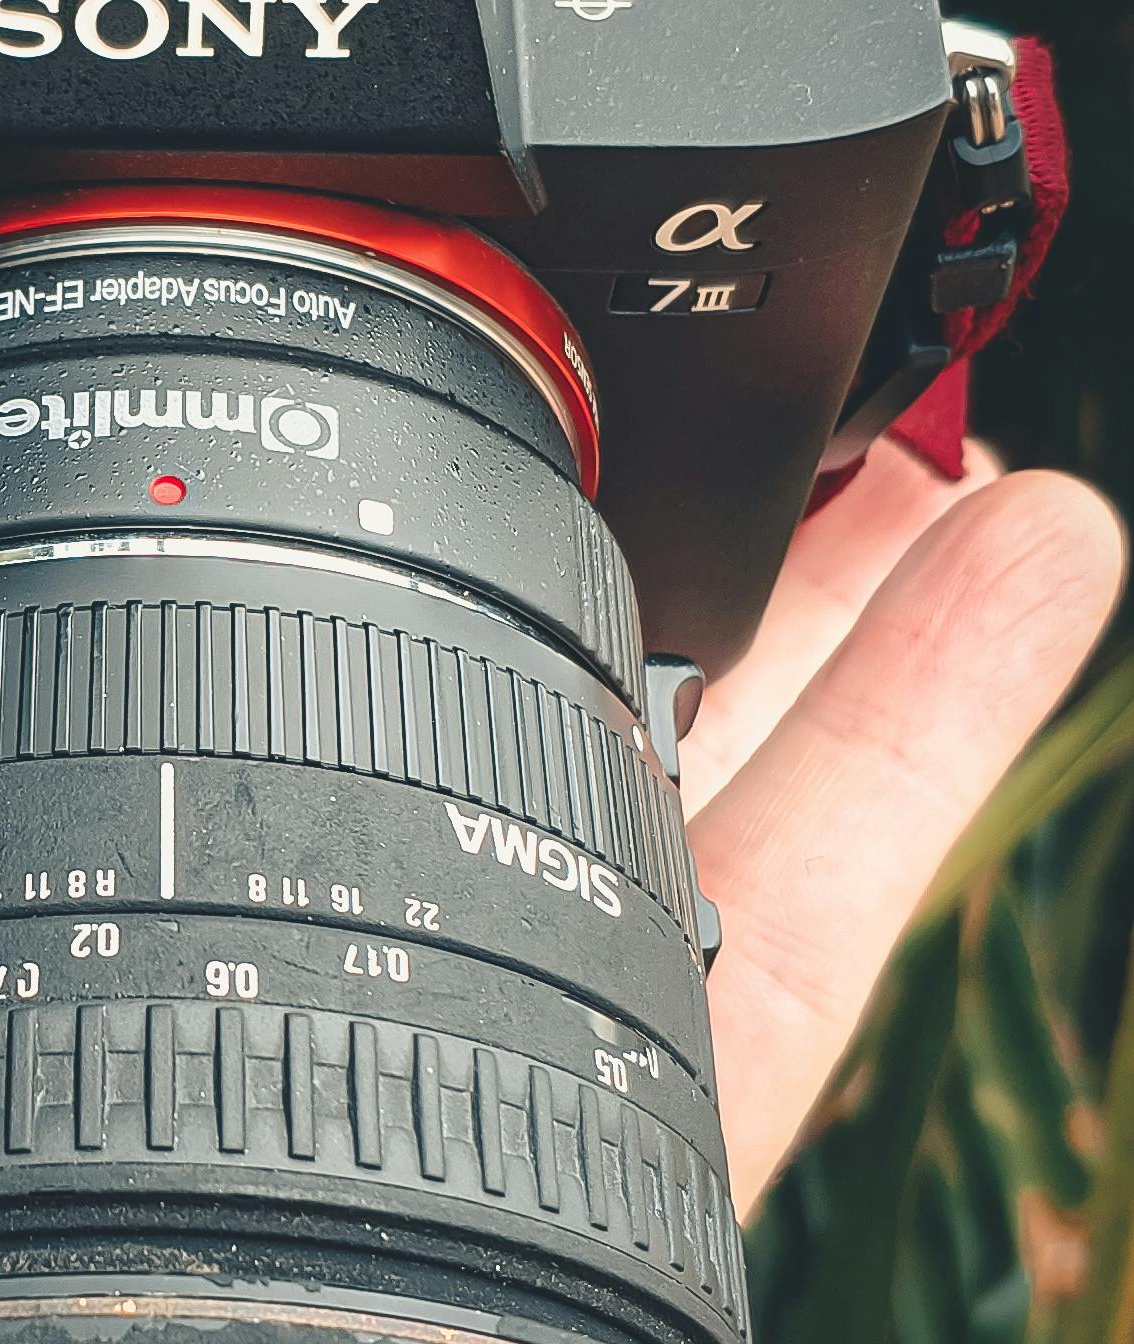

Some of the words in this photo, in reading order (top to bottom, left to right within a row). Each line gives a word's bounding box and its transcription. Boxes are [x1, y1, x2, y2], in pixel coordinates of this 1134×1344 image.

[89, 269, 200, 308] Adapter
[203, 278, 287, 319] Focus
[292, 281, 357, 330] Auto
[442, 800, 623, 918] SIGMA
[23, 871, 52, 901] 11
[68, 869, 86, 898] 8
[96, 869, 116, 898] R
[247, 872, 268, 904] 8
[282, 876, 310, 908] 11
[330, 883, 364, 917] 16
[403, 896, 441, 933] 22
[69, 921, 121, 959] 0.2
[204, 959, 259, 999] 0.6
[343, 942, 411, 984] 0.17
